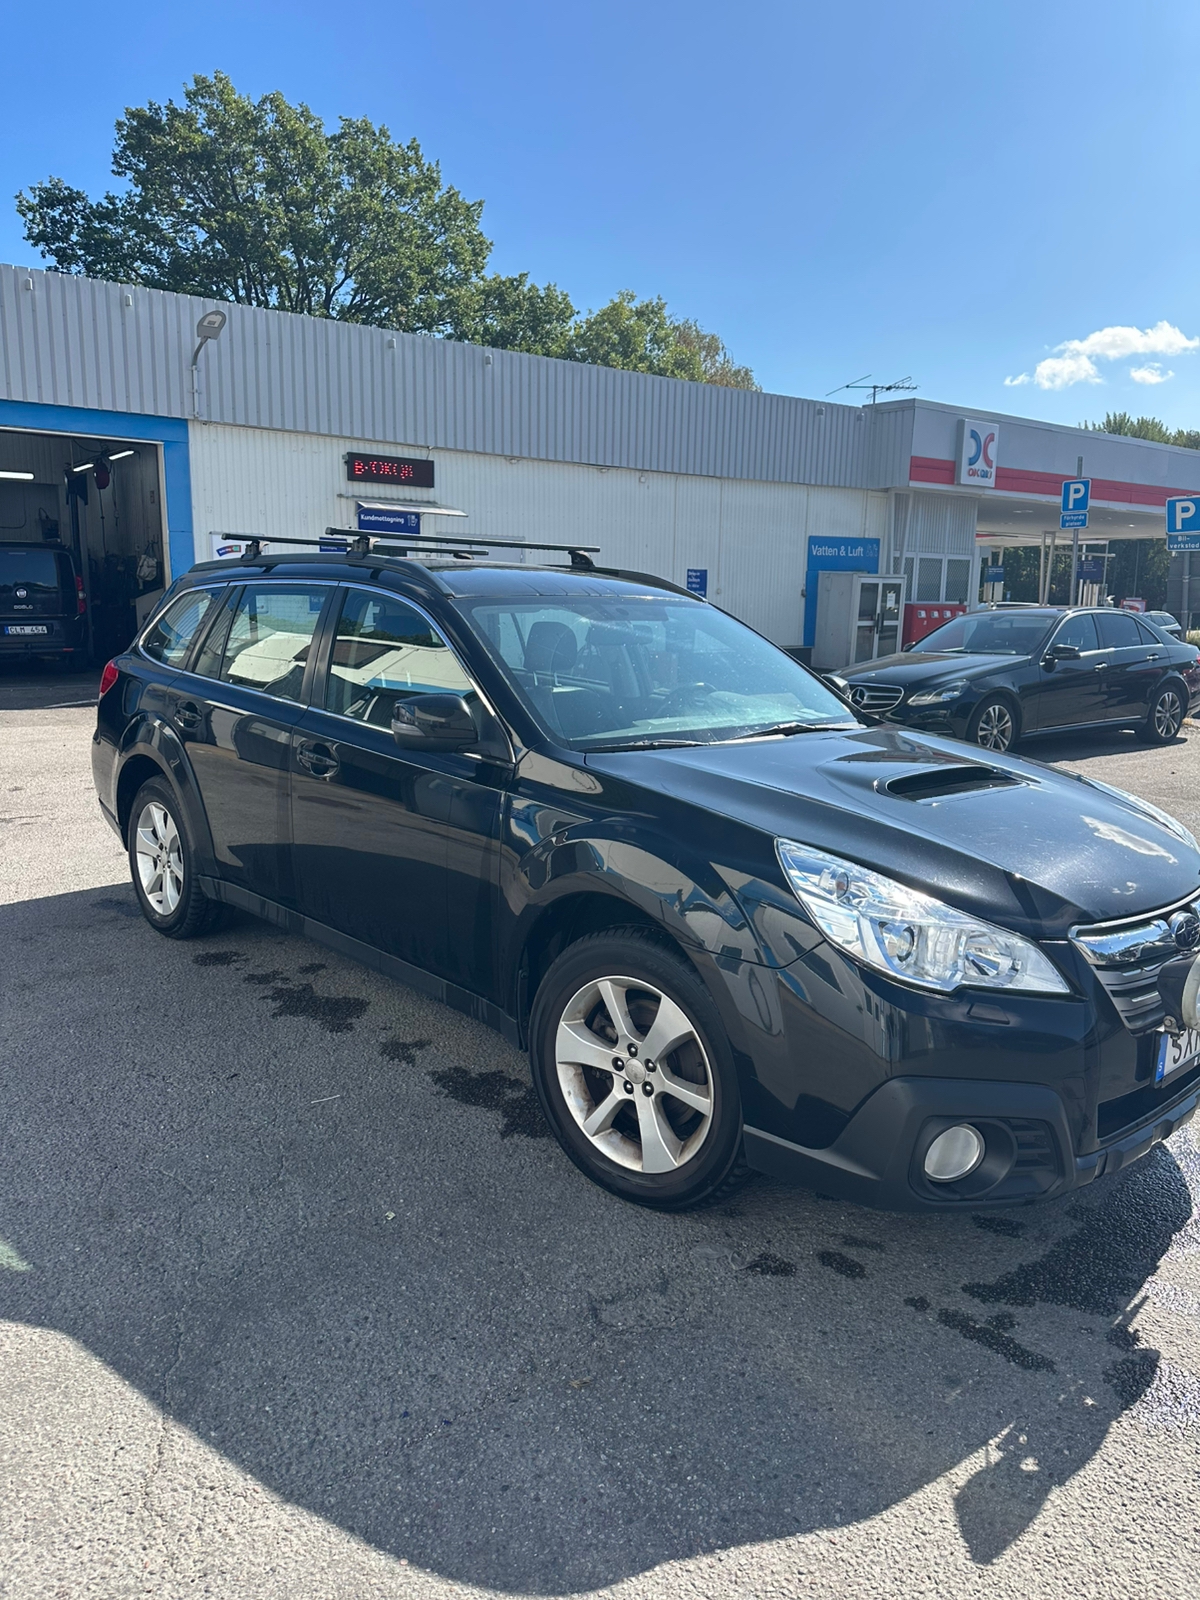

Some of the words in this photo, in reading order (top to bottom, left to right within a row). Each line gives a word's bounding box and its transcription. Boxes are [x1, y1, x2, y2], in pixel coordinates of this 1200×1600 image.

[1068, 483, 1085, 509] P
[360, 513, 405, 525] Kundmottagning
[1175, 501, 1196, 530] P
[811, 544, 838, 556] Vatten
[840, 545, 846, 556] &
[848, 546, 864, 557] Luft
